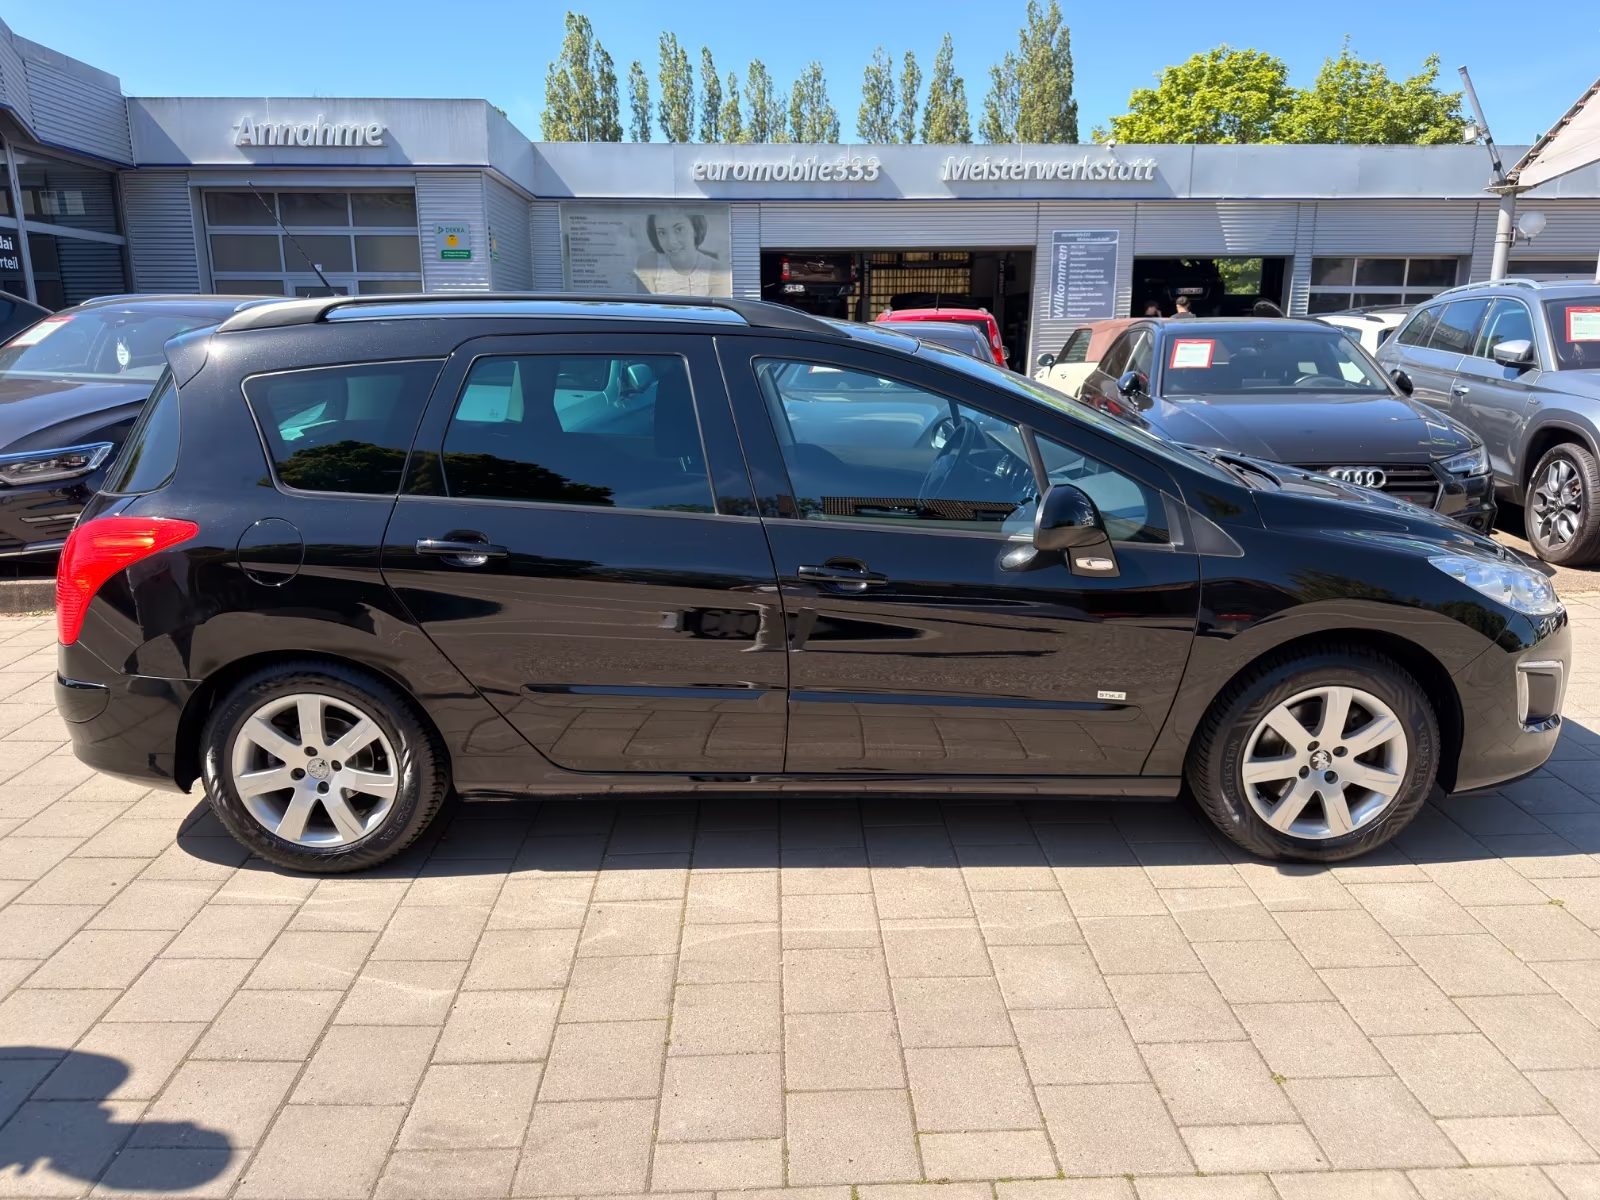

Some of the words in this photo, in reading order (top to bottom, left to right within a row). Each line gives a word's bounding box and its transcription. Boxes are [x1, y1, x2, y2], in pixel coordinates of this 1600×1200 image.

[234, 113, 384, 146] Annahme
[691, 155, 880, 182] euromobile333
[943, 155, 1157, 181] Meisterwerkstatt
[1053, 244, 1068, 318] Wilkommen
